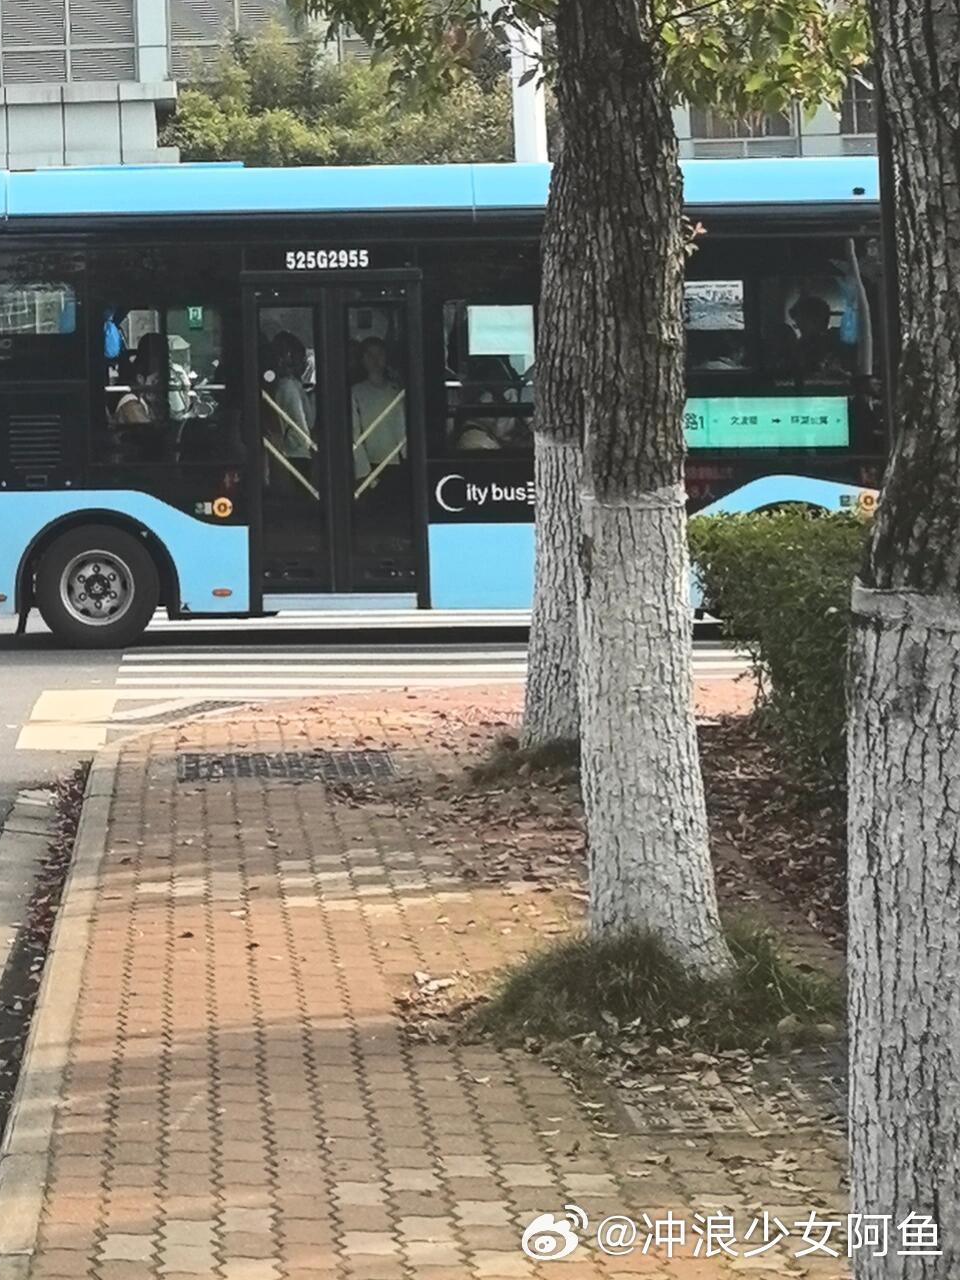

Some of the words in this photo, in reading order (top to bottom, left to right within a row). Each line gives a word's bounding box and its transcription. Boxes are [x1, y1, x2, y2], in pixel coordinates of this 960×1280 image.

[285, 249, 369, 269] 525G2955
[435, 474, 488, 512] City
[491, 483, 527, 501] bus
